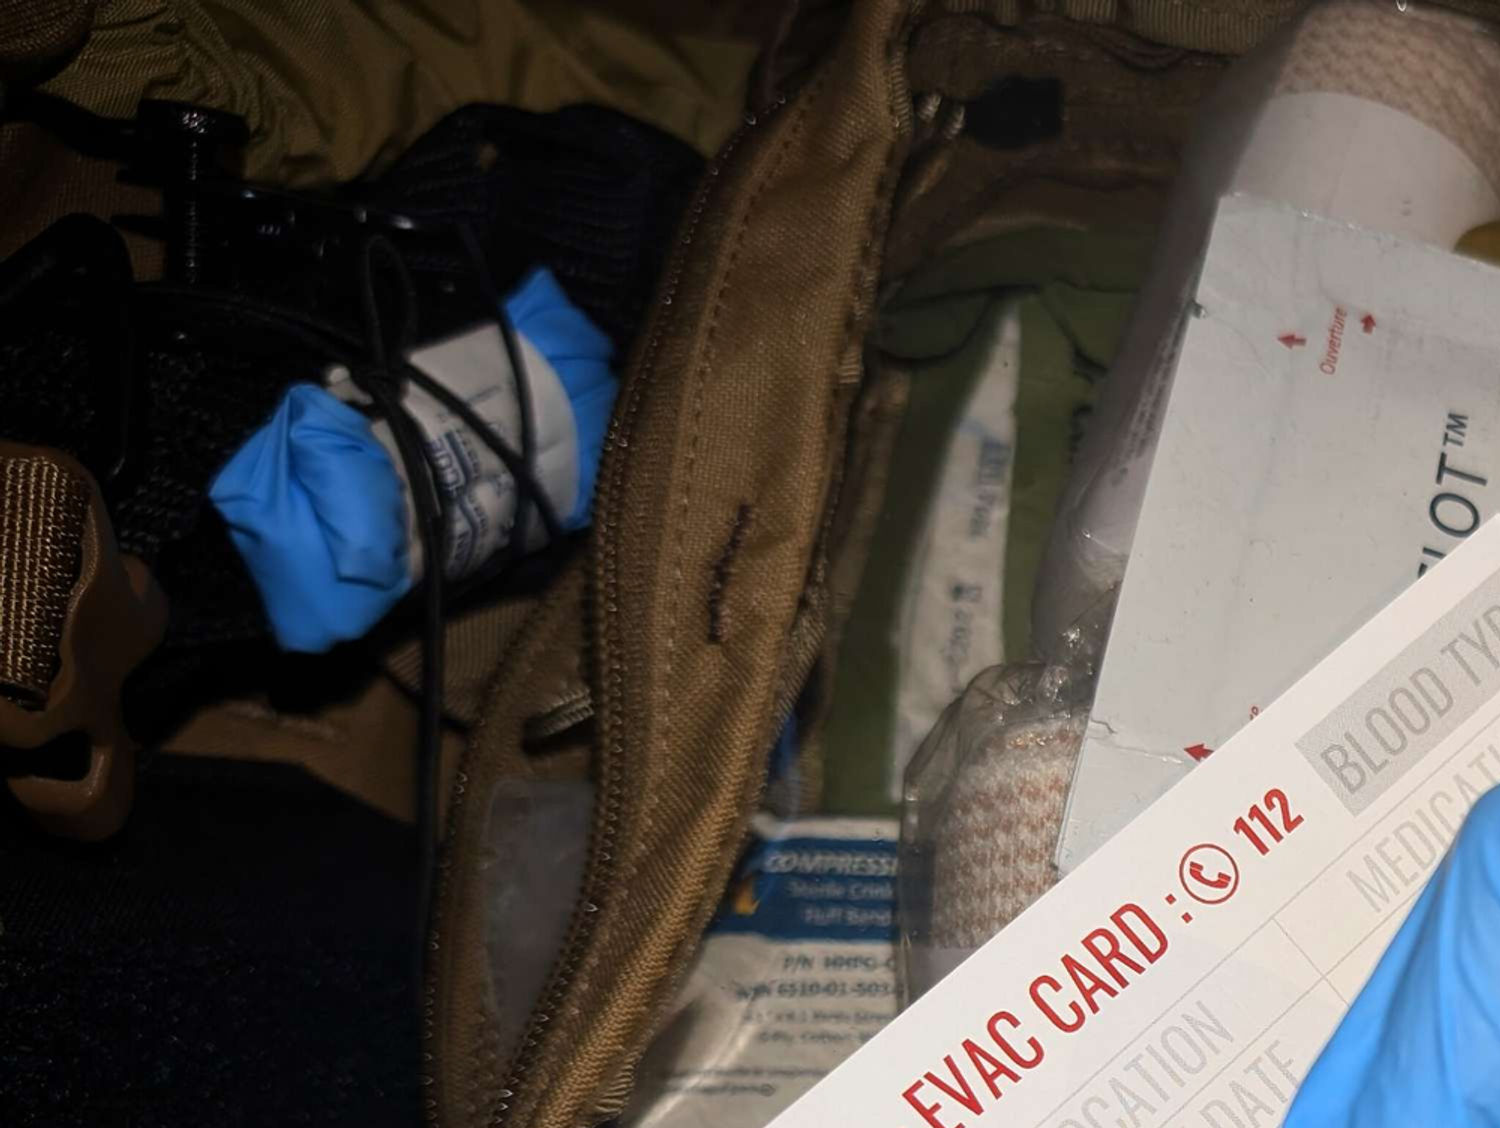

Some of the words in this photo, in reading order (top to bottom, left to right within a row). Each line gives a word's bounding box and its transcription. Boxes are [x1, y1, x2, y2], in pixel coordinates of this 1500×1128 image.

[1320, 306, 1347, 375] Ouverture
[1320, 667, 1455, 794] BLOOD
[1029, 902, 1168, 1033] CARD
[1233, 788, 1305, 856] 112
